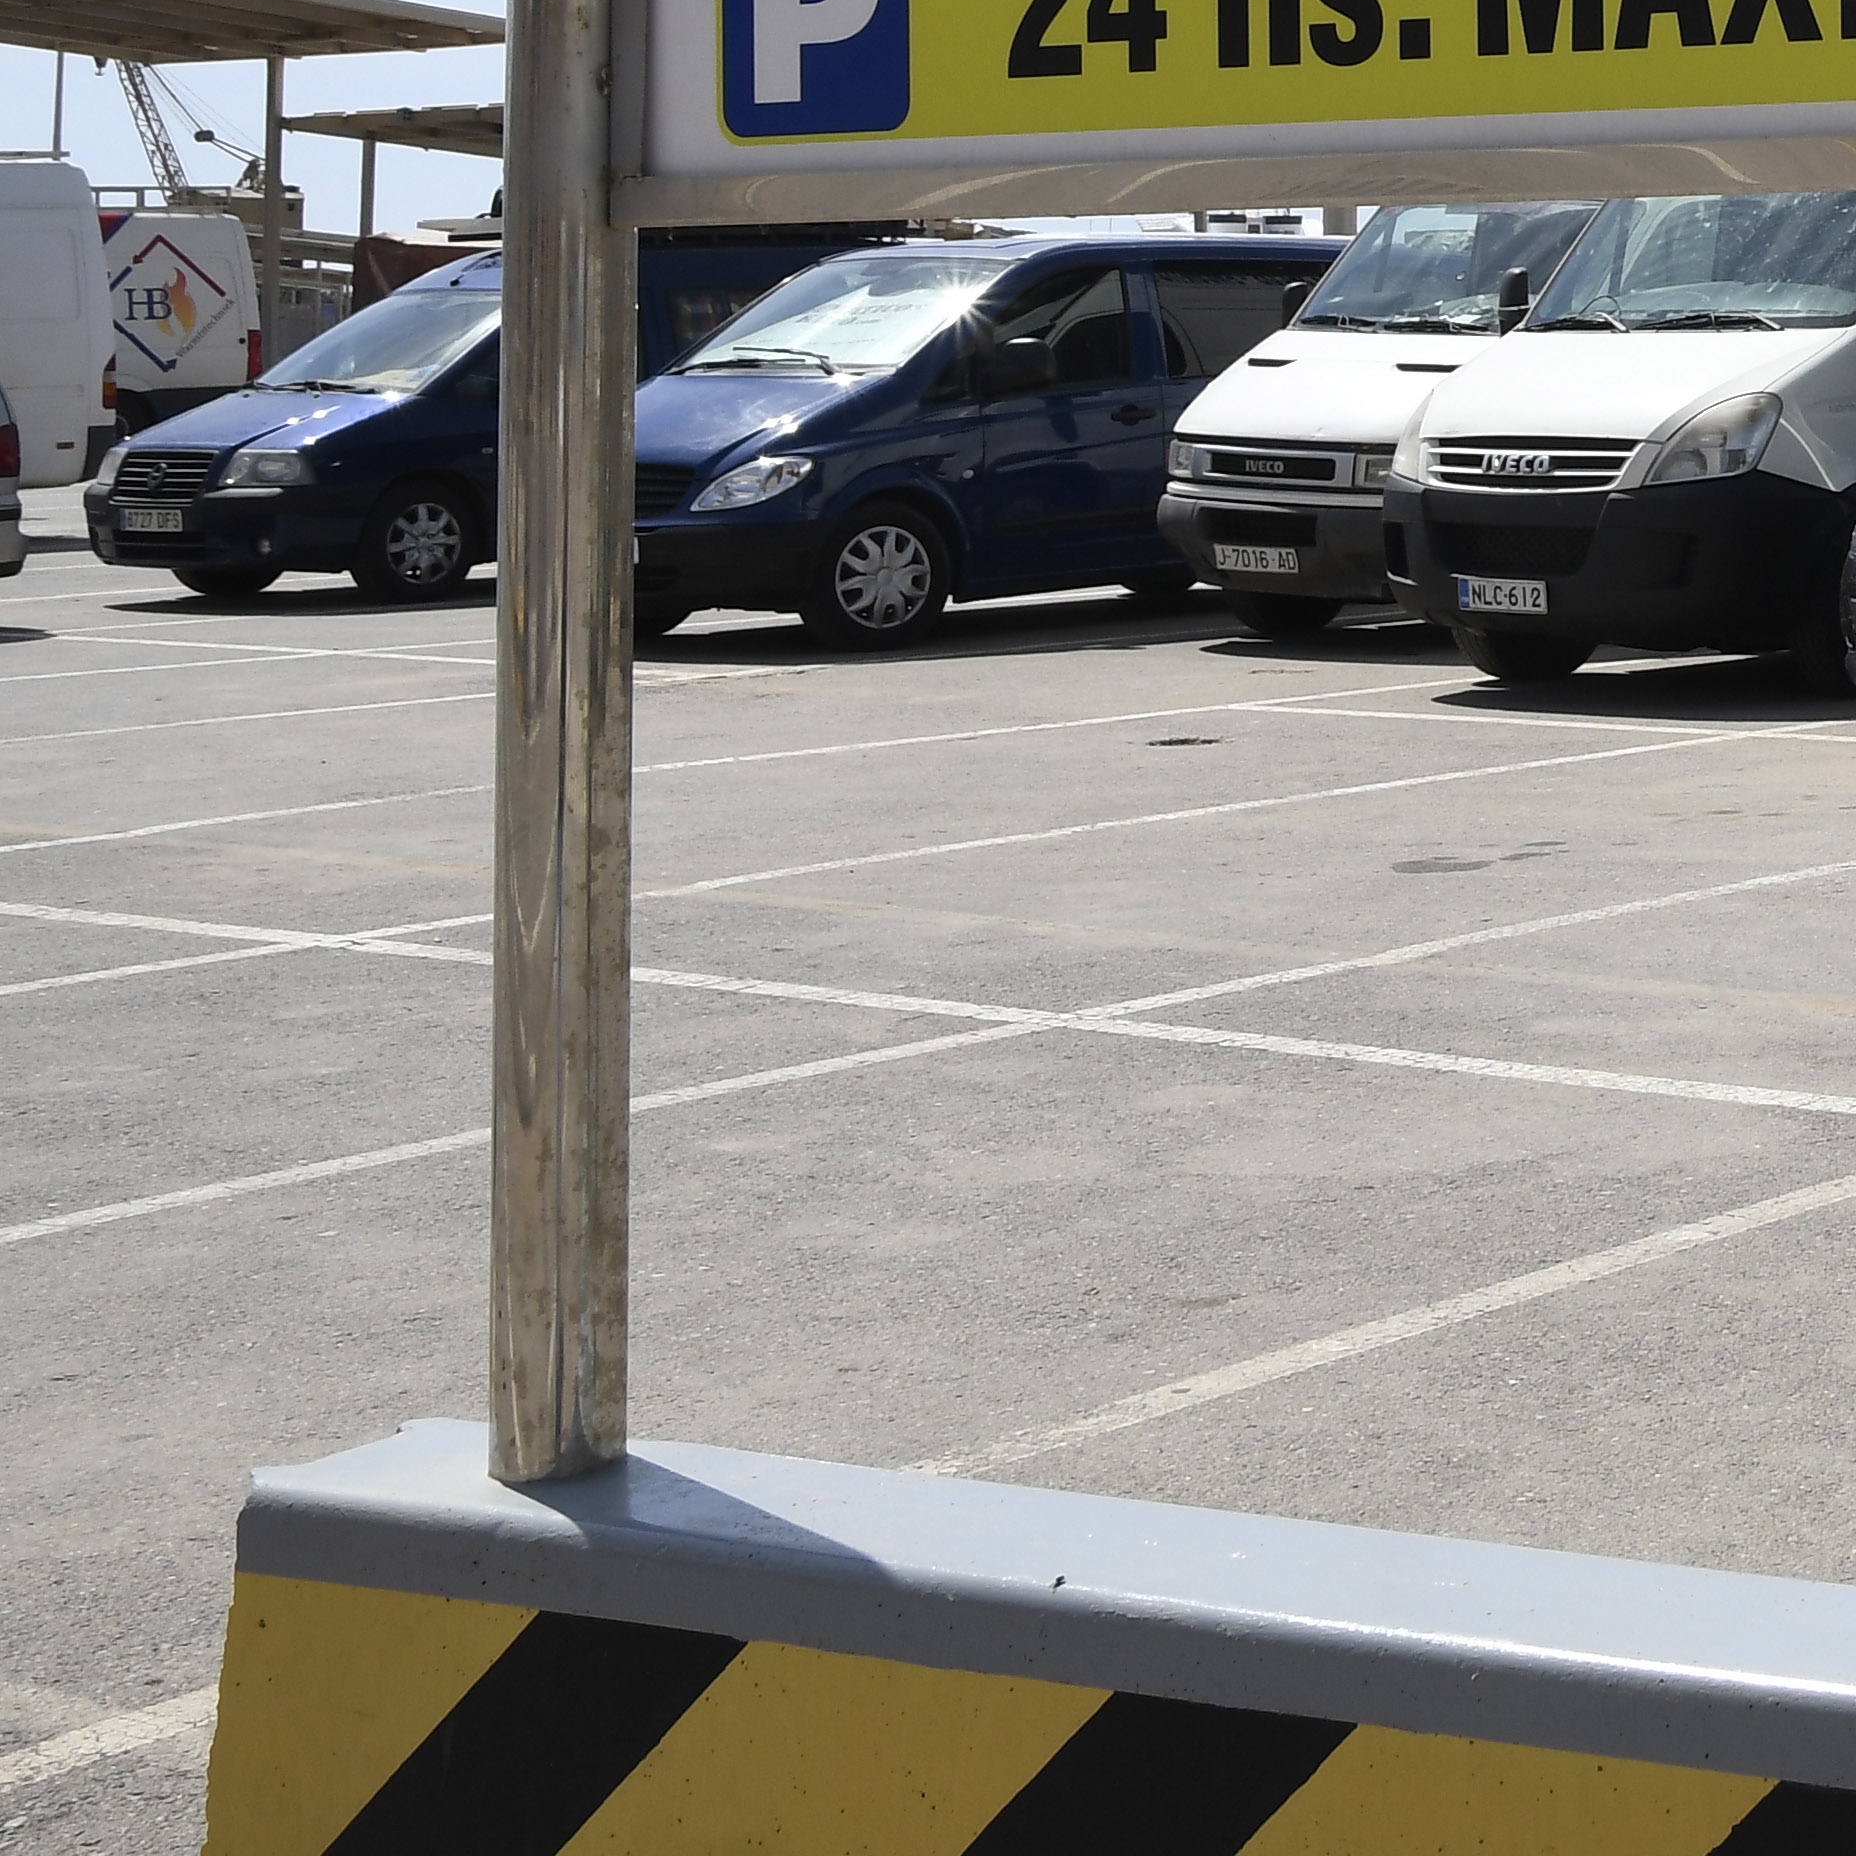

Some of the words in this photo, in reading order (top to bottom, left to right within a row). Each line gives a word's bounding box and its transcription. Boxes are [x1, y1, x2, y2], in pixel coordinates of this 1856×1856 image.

[124, 288, 172, 320] HB
[1245, 459, 1285, 474] IVECO
[1481, 454, 1551, 474] IVECO
